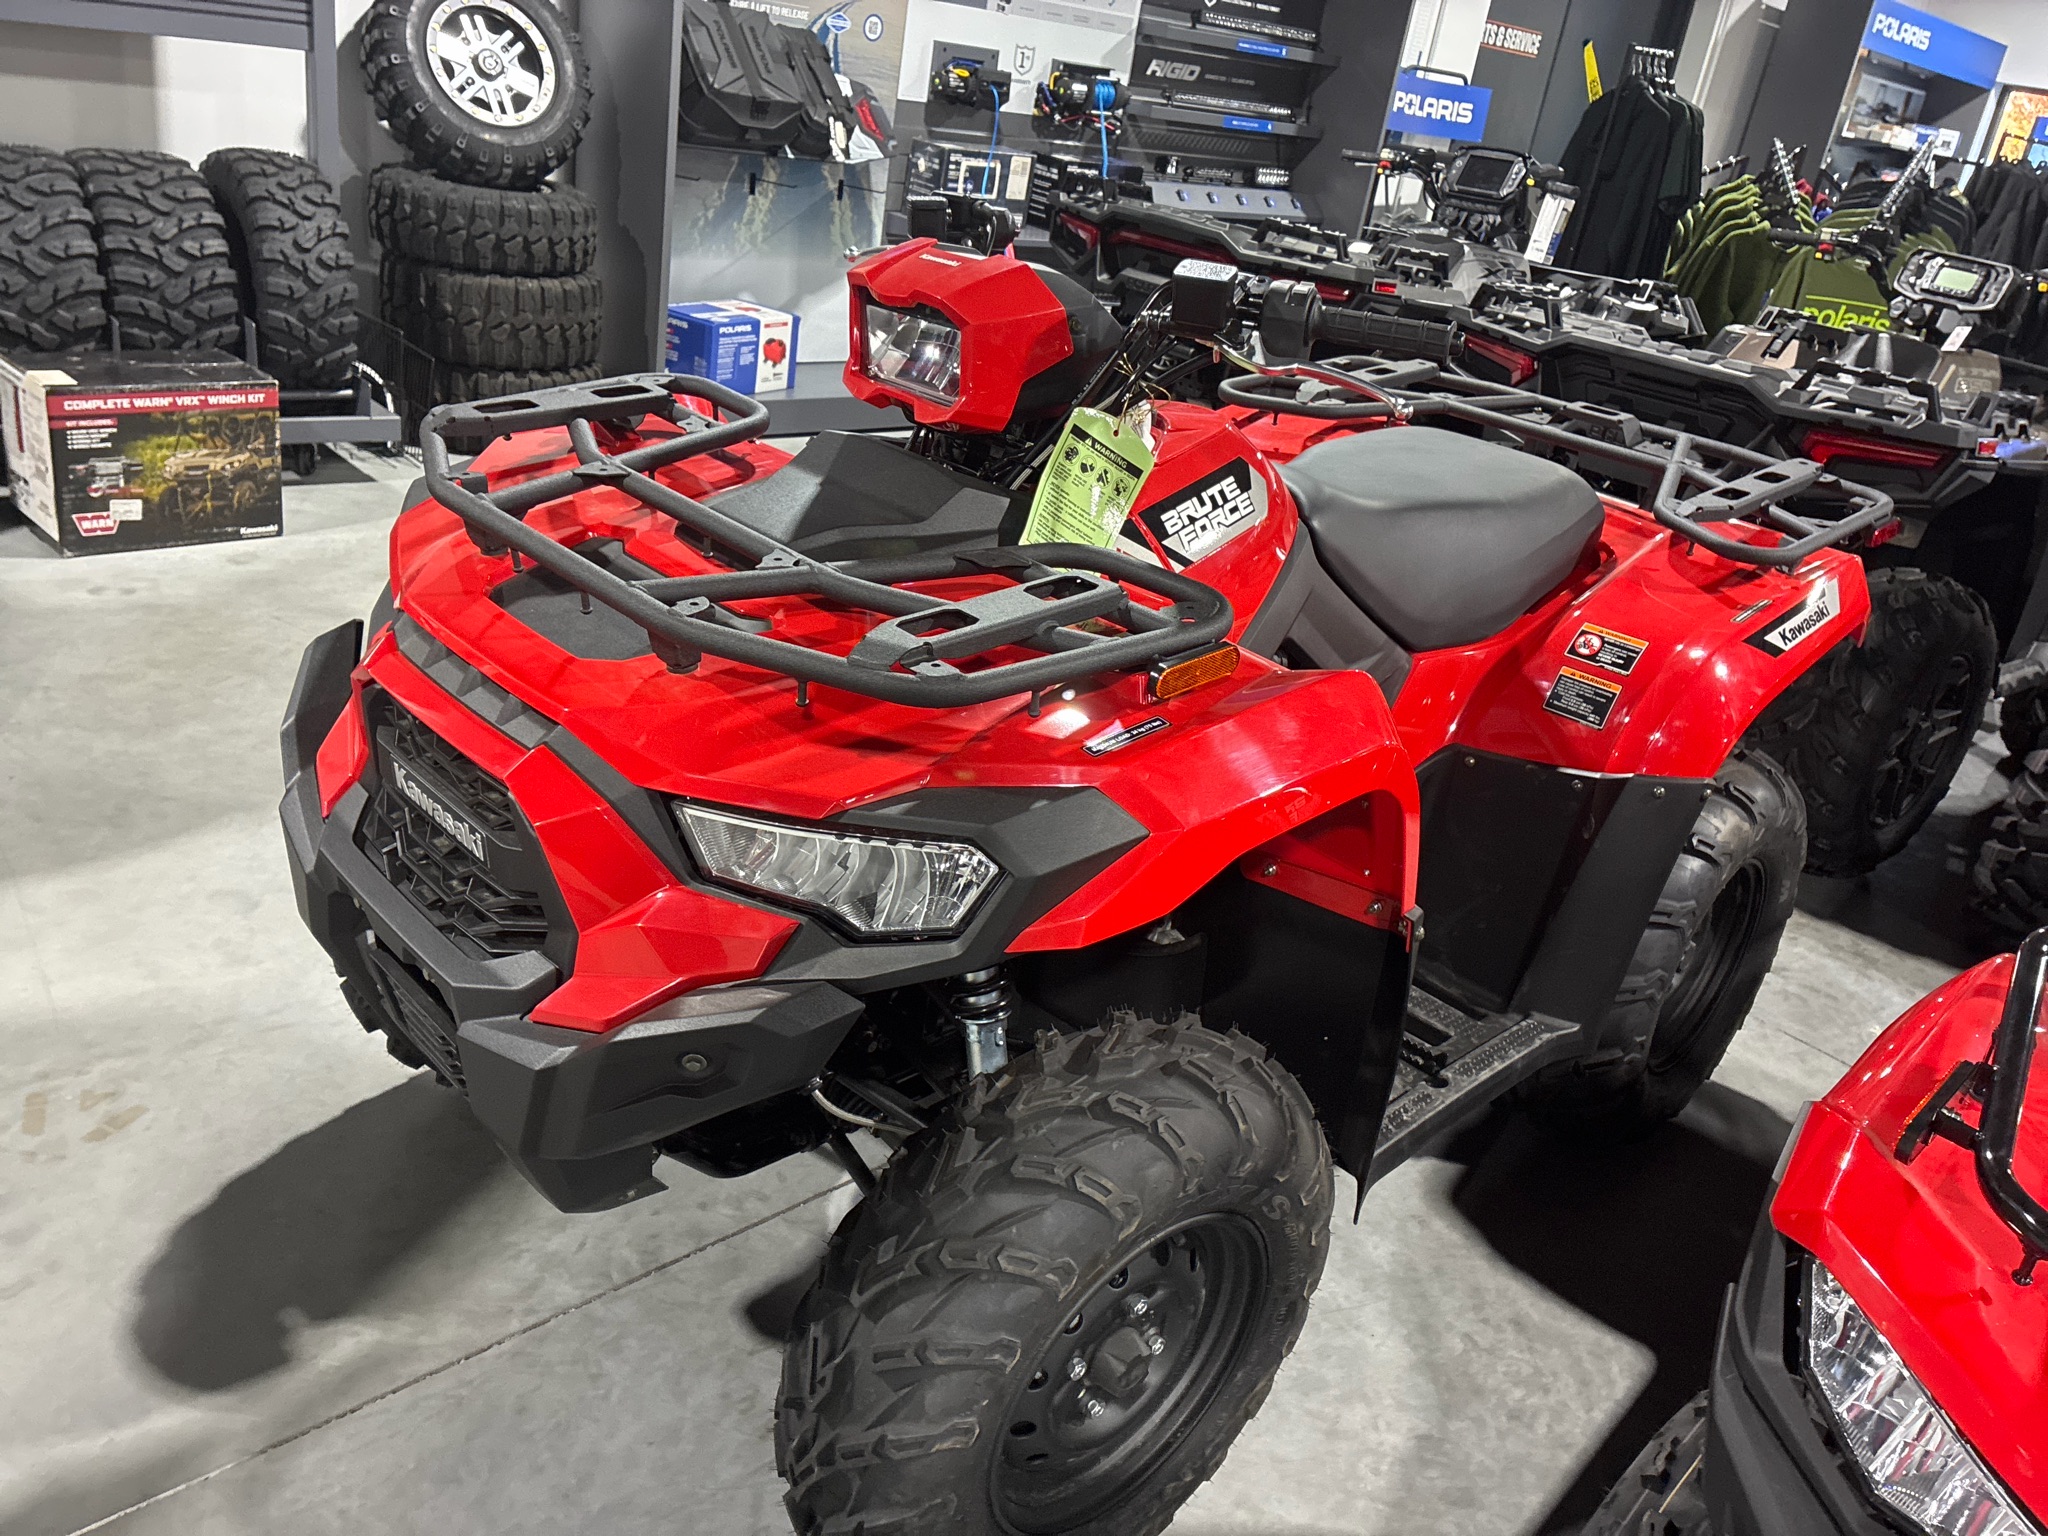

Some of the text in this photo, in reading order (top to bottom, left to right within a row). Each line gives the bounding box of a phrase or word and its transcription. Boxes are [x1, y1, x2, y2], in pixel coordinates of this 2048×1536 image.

[771, 6, 780, 14] TO
[781, 7, 809, 20] RELEASE
[1504, 28, 1542, 54] SERVICE
[1872, 13, 1931, 51] POLARIS
[1146, 59, 1201, 81] RIGID
[1393, 91, 1474, 124] POLARIS
[719, 324, 752, 334] POLARIS
[64, 399, 130, 411] COMPLETE
[207, 393, 246, 405] WINCH
[247, 393, 266, 404] KIT
[1095, 441, 1128, 468] WARNING
[1160, 475, 1242, 535] BRUTE
[81, 518, 114, 530] WARN
[240, 523, 279, 535] Kawasaki
[1178, 491, 1256, 553] FORCE
[1778, 601, 1831, 647] Kawasaki
[1604, 630, 1632, 643] WARNING
[1578, 673, 1613, 690] WARNING
[394, 762, 484, 861] Kawasaki
